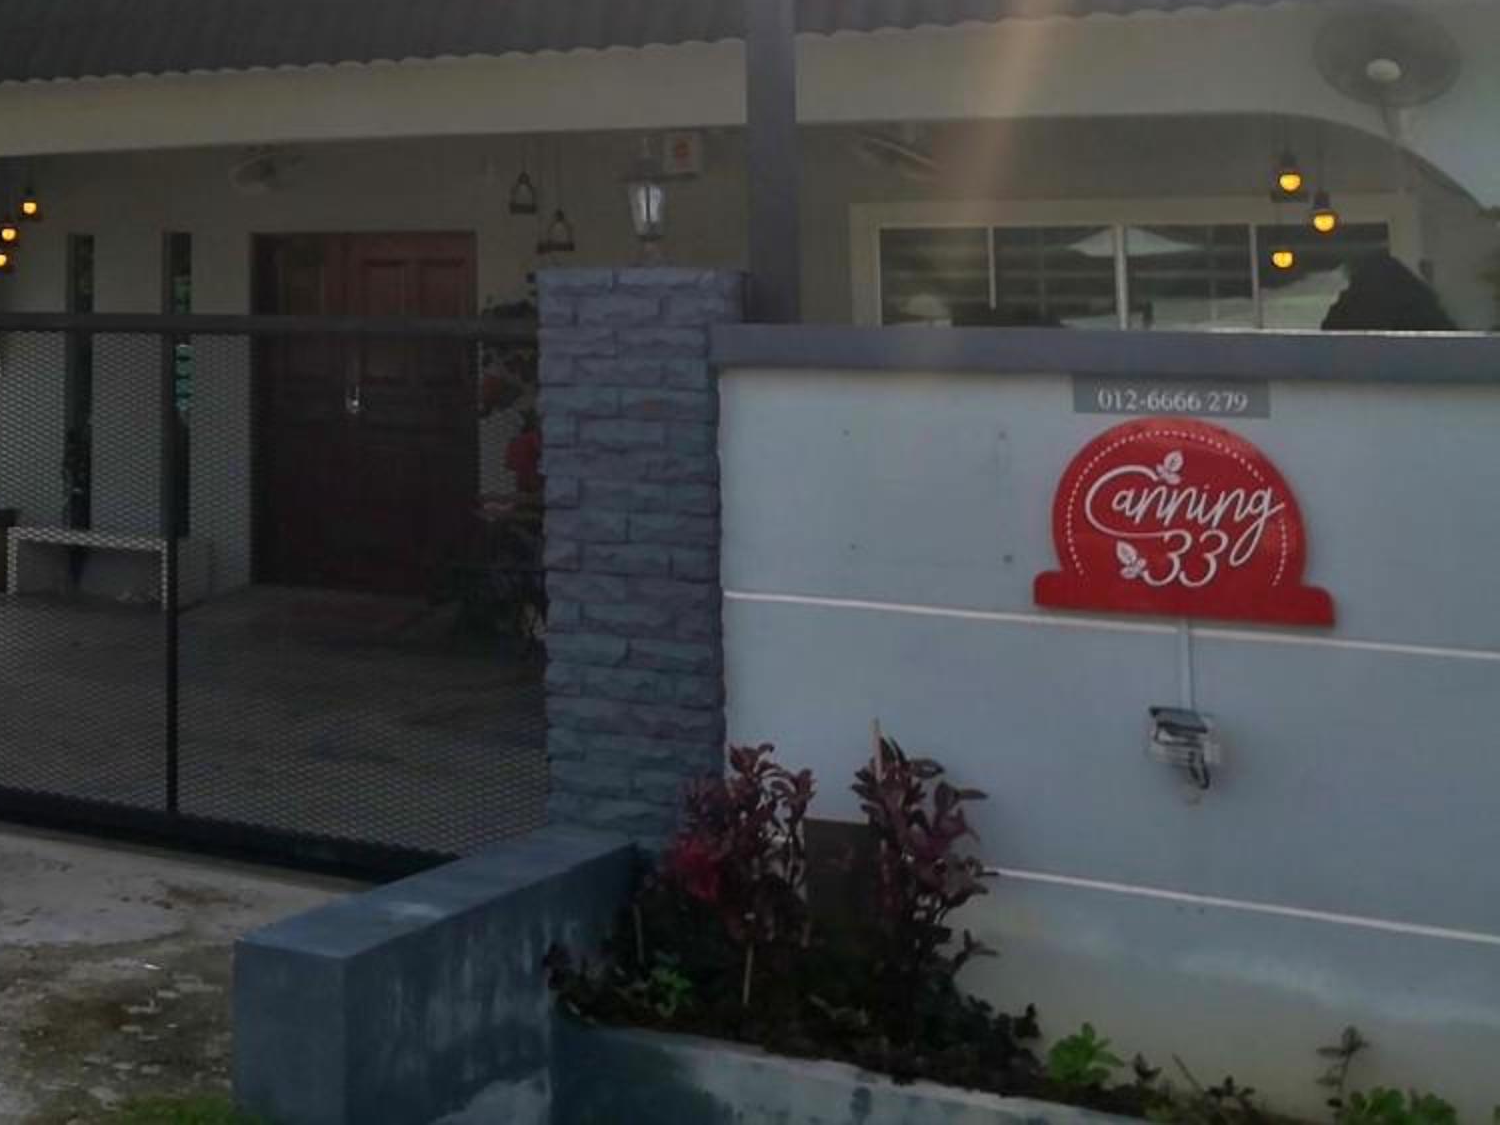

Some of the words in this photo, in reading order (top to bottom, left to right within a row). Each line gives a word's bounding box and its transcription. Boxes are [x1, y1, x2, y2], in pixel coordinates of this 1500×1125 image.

[1098, 388, 1201, 412] 012-6666
[1207, 390, 1249, 412] 279
[1085, 464, 1285, 567] Canning
[1142, 530, 1230, 587] 33
